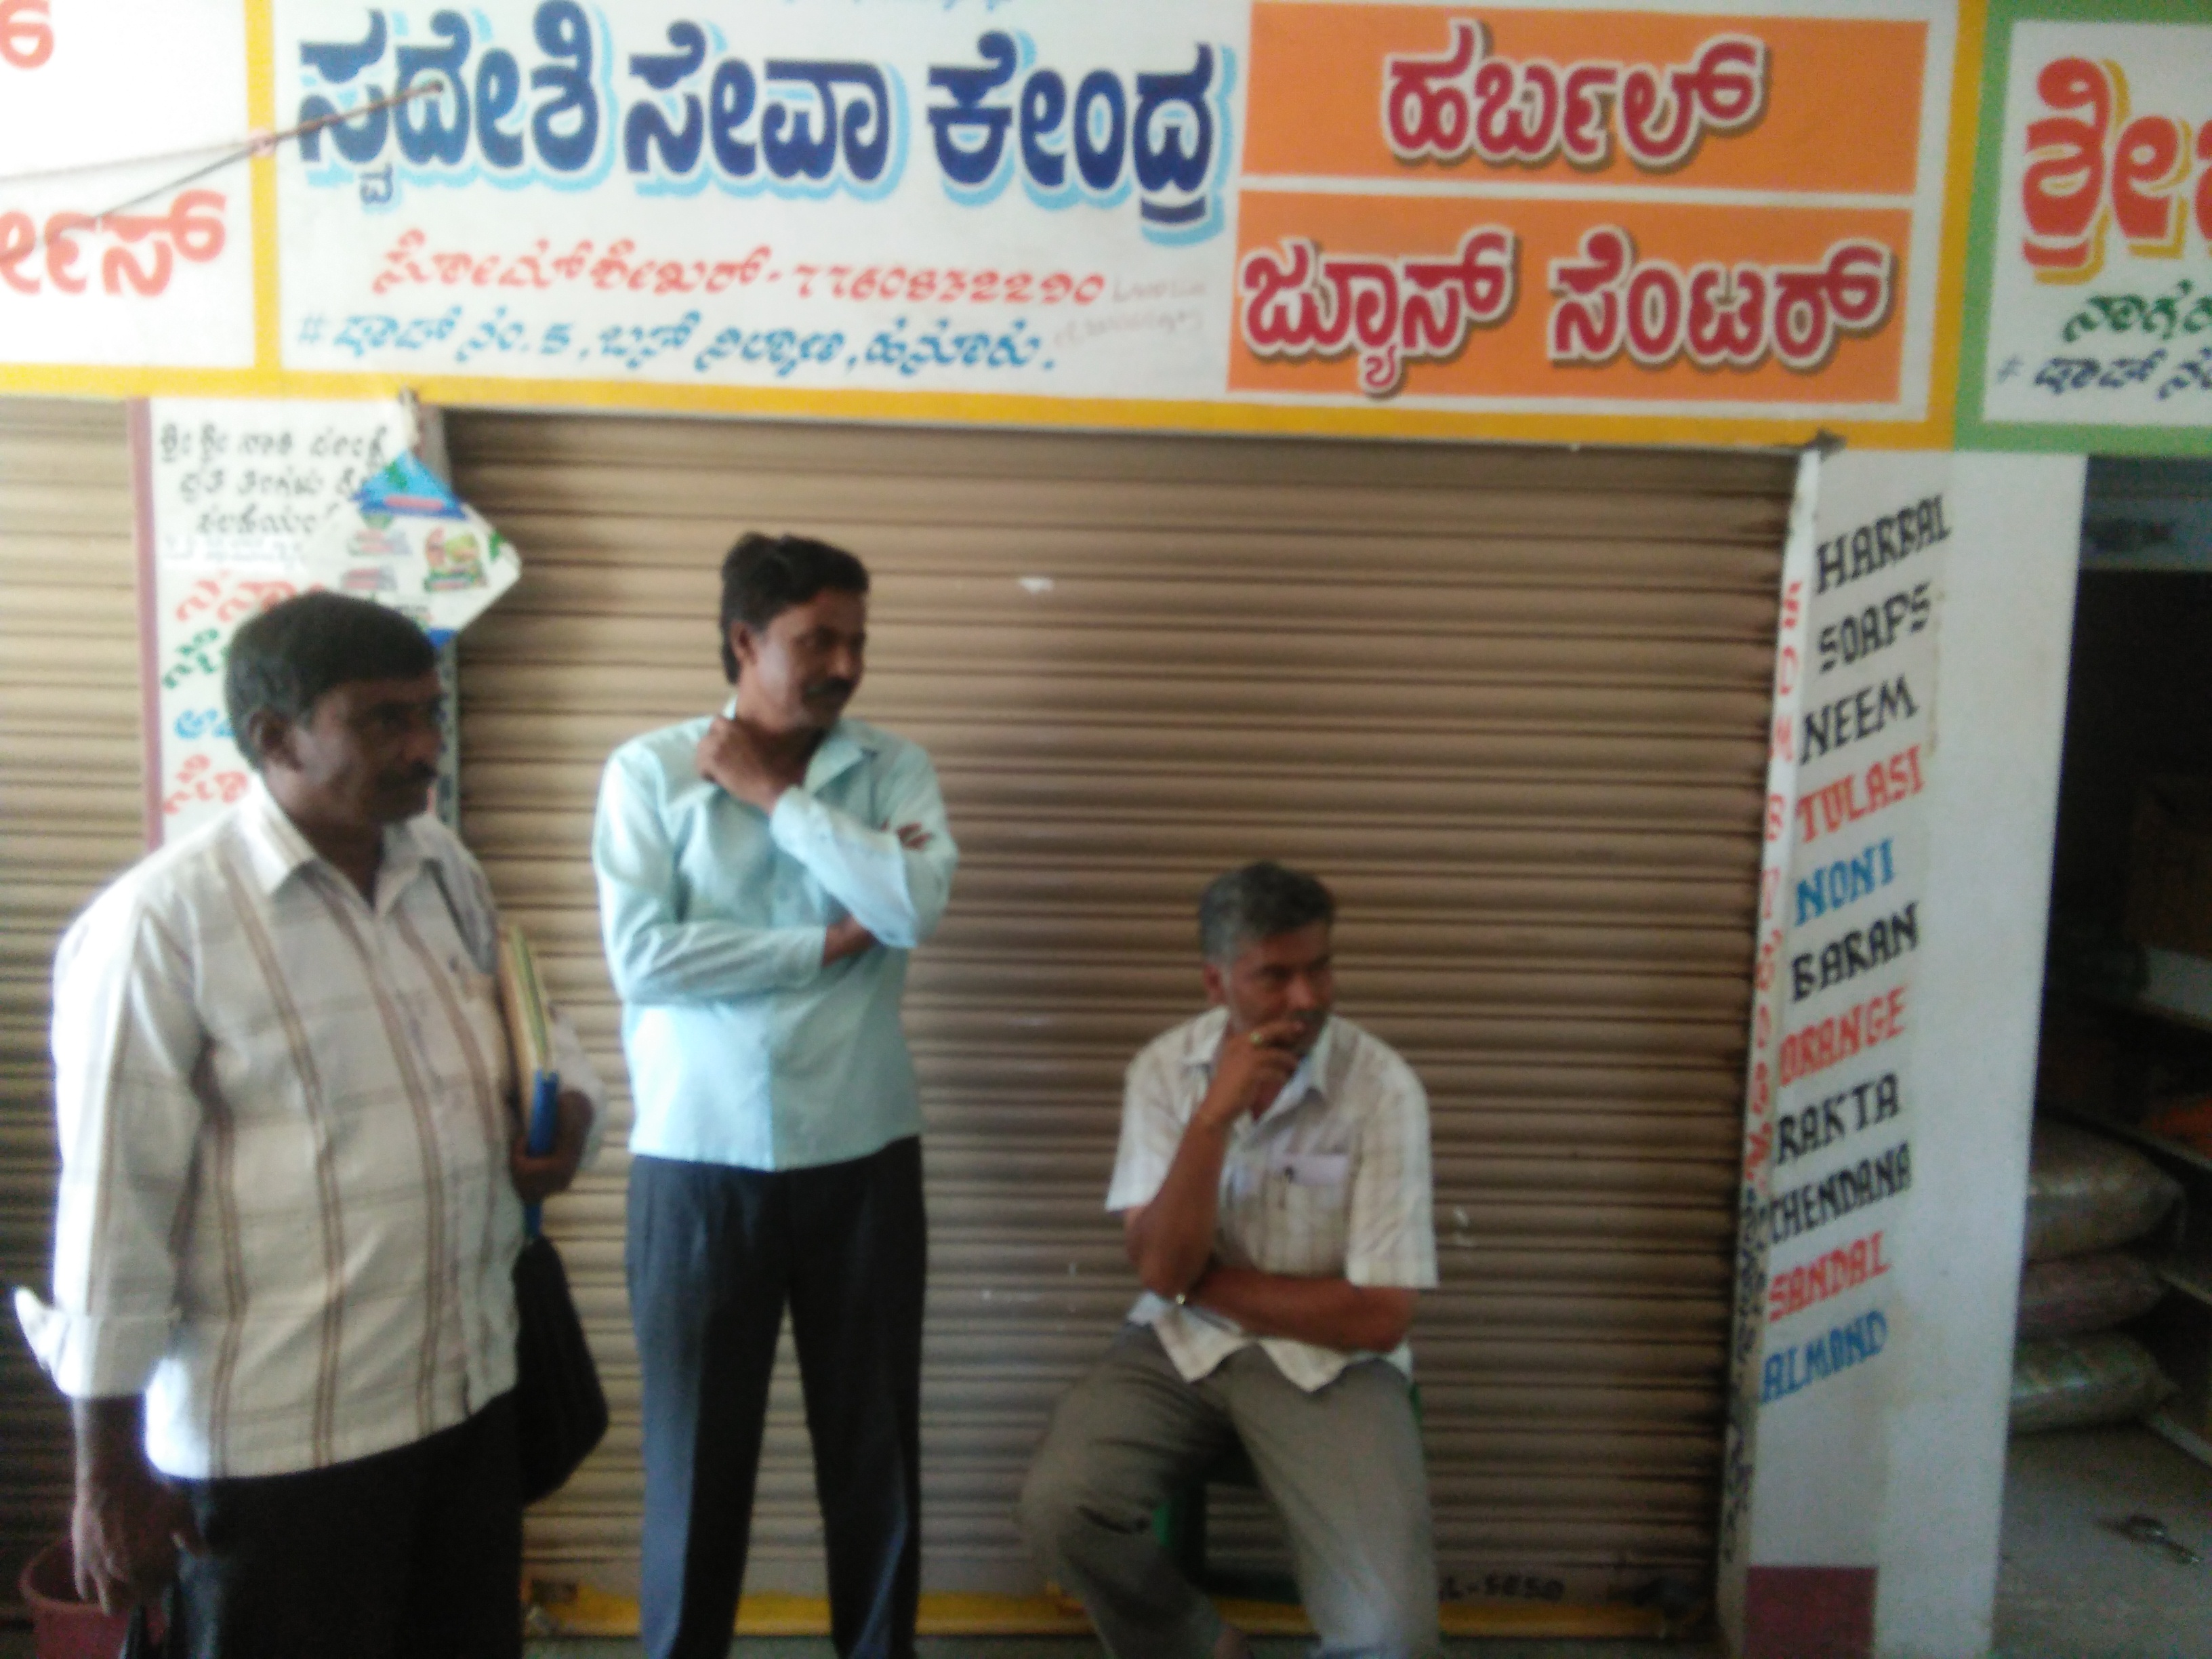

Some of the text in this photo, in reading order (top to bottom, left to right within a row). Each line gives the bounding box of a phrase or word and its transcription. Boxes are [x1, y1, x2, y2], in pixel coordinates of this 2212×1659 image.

[299, 0, 1216, 226] ಸ್ವದೇಶಿ ಸೇವಾ ಕೇಂದ್ರ
[1387, 22, 1762, 163] ಹರ್ಬಲ್
[1242, 229, 1889, 390] ಜ್ಯೂಸ್ ಸೆಂಟರ್
[1818, 581, 1931, 675] SOAPS
[1799, 672, 1920, 766] NEEM
[1796, 743, 1925, 844] TULASI
[1795, 836, 1895, 928] NONI
[1779, 985, 1906, 1087] ORANGE
[1777, 1071, 1900, 1166] RAKTA
[1768, 1229, 1892, 1323] SANDAL
[1761, 1309, 1888, 1404] ALMOND
